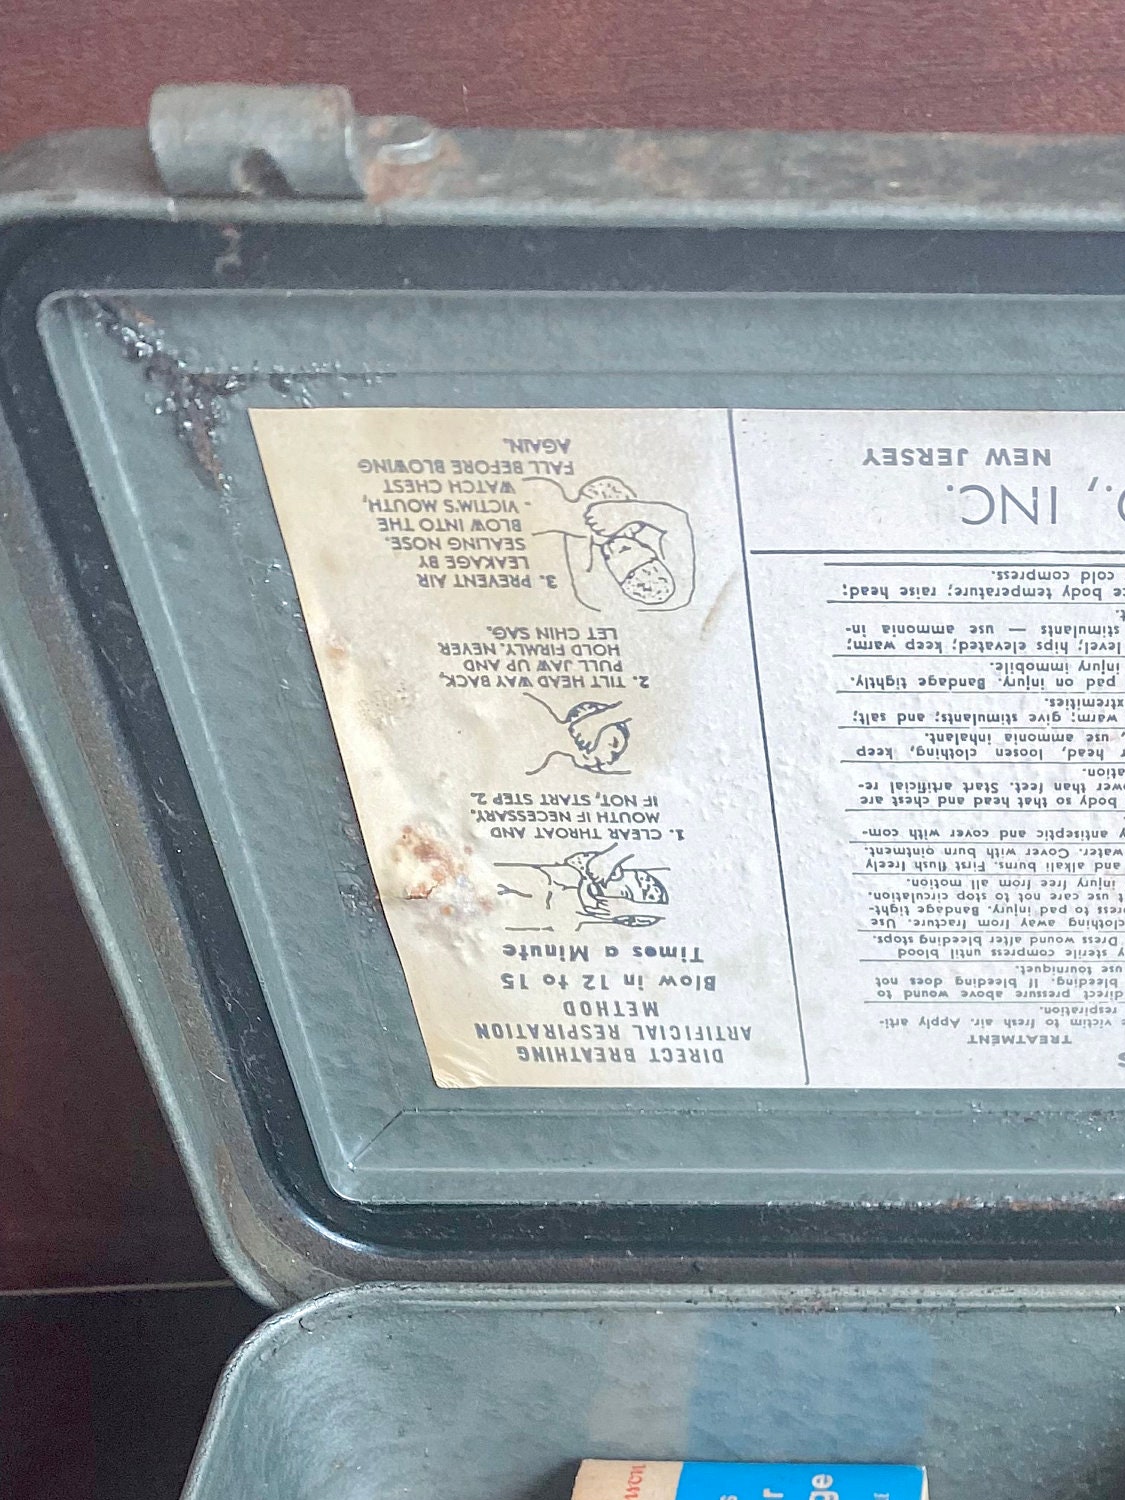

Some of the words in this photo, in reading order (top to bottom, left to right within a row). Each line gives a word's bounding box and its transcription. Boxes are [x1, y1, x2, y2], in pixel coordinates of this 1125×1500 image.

[861, 447, 970, 467] JERSEY
[984, 447, 1052, 467] NEW
[356, 458, 447, 475] BLOWING
[449, 459, 525, 476] BEFORE
[527, 459, 575, 478] FALL
[382, 478, 443, 495] CHEST
[447, 479, 517, 495] WATCH
[362, 494, 438, 514] MOUTH,
[442, 498, 521, 515] VICTIM'S
[946, 483, 1058, 526] INC.
[375, 517, 416, 533] THE
[418, 517, 465, 533] INTO
[469, 518, 523, 533] BLOW
[384, 535, 443, 552] NOSE.
[446, 536, 527, 552] SEALING
[417, 554, 441, 570] BY
[443, 554, 531, 571] LEAKAGE
[415, 573, 448, 589] AIR
[452, 573, 533, 589] PREVENT
[538, 574, 559, 590] 3.
[989, 568, 1071, 583] compress.
[1079, 571, 1115, 585] cold
[841, 583, 889, 600] head;
[897, 585, 937, 600] raise
[946, 582, 1052, 600] temperature;
[1060, 583, 1102, 601] body
[485, 625, 531, 641] SAG.
[534, 626, 581, 641] CHIN
[586, 626, 619, 641] LET
[436, 641, 496, 657] NEVER
[499, 641, 566, 657] FIRMLY.
[568, 642, 620, 657] HOLD
[462, 658, 501, 673] AND
[505, 658, 532, 673] UP
[535, 658, 574, 673] JAW
[577, 659, 624, 673] PULL
[437, 671, 492, 689] BACK,
[495, 673, 533, 688] WAY
[536, 674, 585, 689] HEAD
[591, 675, 626, 690] TILT
[632, 675, 650, 690] 2.
[469, 792, 488, 806] 2.
[492, 792, 534, 806] STEP
[539, 793, 592, 807] START
[593, 791, 638, 806] NOT,
[642, 795, 659, 808] IF
[470, 808, 572, 824] NECESSARY.
[576, 811, 592, 823] IF
[594, 810, 661, 824] MOUTH
[489, 826, 526, 840] AND
[533, 826, 603, 840] THROAT
[607, 827, 663, 841] CLEAR
[668, 828, 686, 842] 1.
[502, 943, 590, 963] Minute
[604, 945, 620, 958] a
[632, 945, 705, 964] Times
[500, 972, 530, 991] 15
[542, 973, 569, 991] to
[581, 974, 610, 991] 12
[623, 973, 645, 992] in
[657, 974, 716, 992] Blow
[562, 1000, 660, 1018] METHOD
[473, 1022, 621, 1041] RESPIRATION
[631, 1024, 752, 1042] ARTIFICIAL
[966, 1034, 1073, 1047] TREATMENT
[515, 1045, 637, 1064] BREATHING
[648, 1047, 724, 1064] DIRECT
